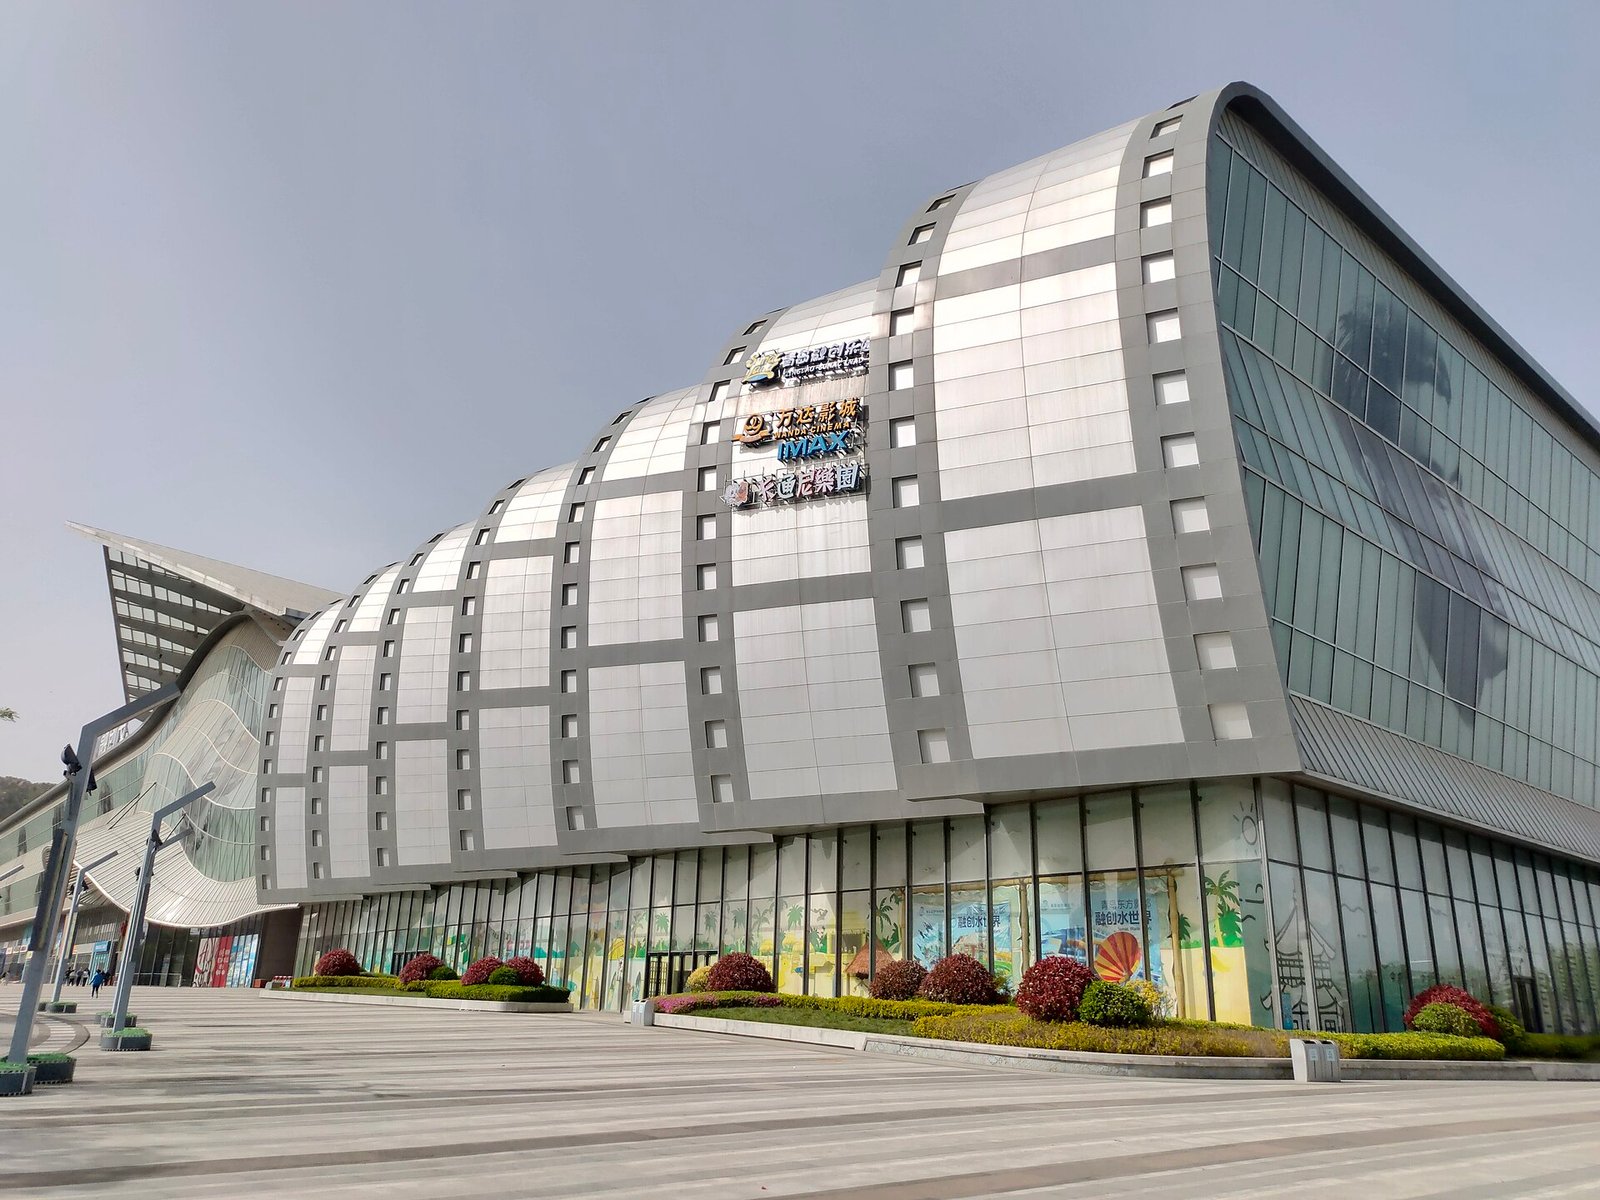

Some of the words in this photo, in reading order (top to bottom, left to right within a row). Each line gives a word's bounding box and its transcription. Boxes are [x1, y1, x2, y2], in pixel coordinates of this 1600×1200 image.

[777, 399, 859, 428] 万达影城
[774, 428, 807, 439] WANDA
[810, 422, 851, 433] CINEMA
[777, 430, 850, 461] IMAX
